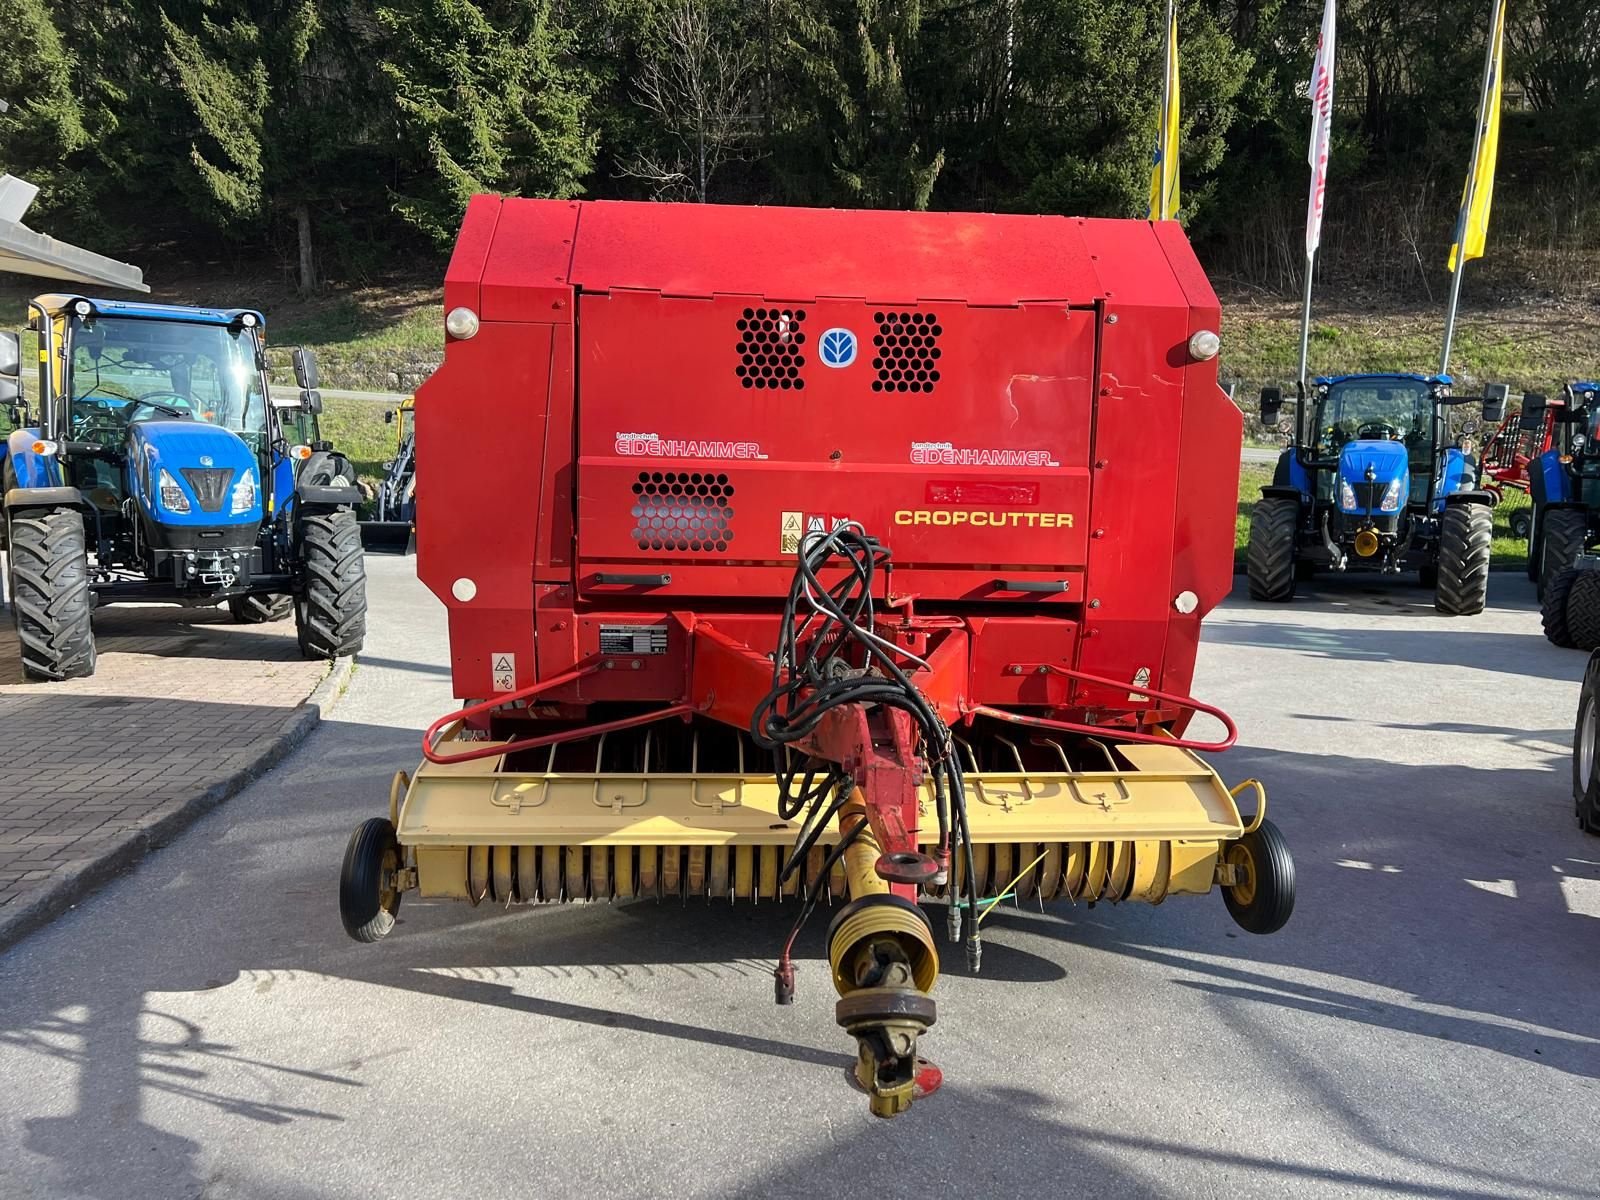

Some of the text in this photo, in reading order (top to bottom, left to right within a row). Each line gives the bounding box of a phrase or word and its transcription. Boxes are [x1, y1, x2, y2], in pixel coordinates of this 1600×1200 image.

[616, 432, 658, 440] Landtechnik
[615, 439, 759, 458] EIDENHAMMER
[910, 449, 1050, 466] EIDENHAMMER
[894, 510, 1074, 527] CROPCUTTER
